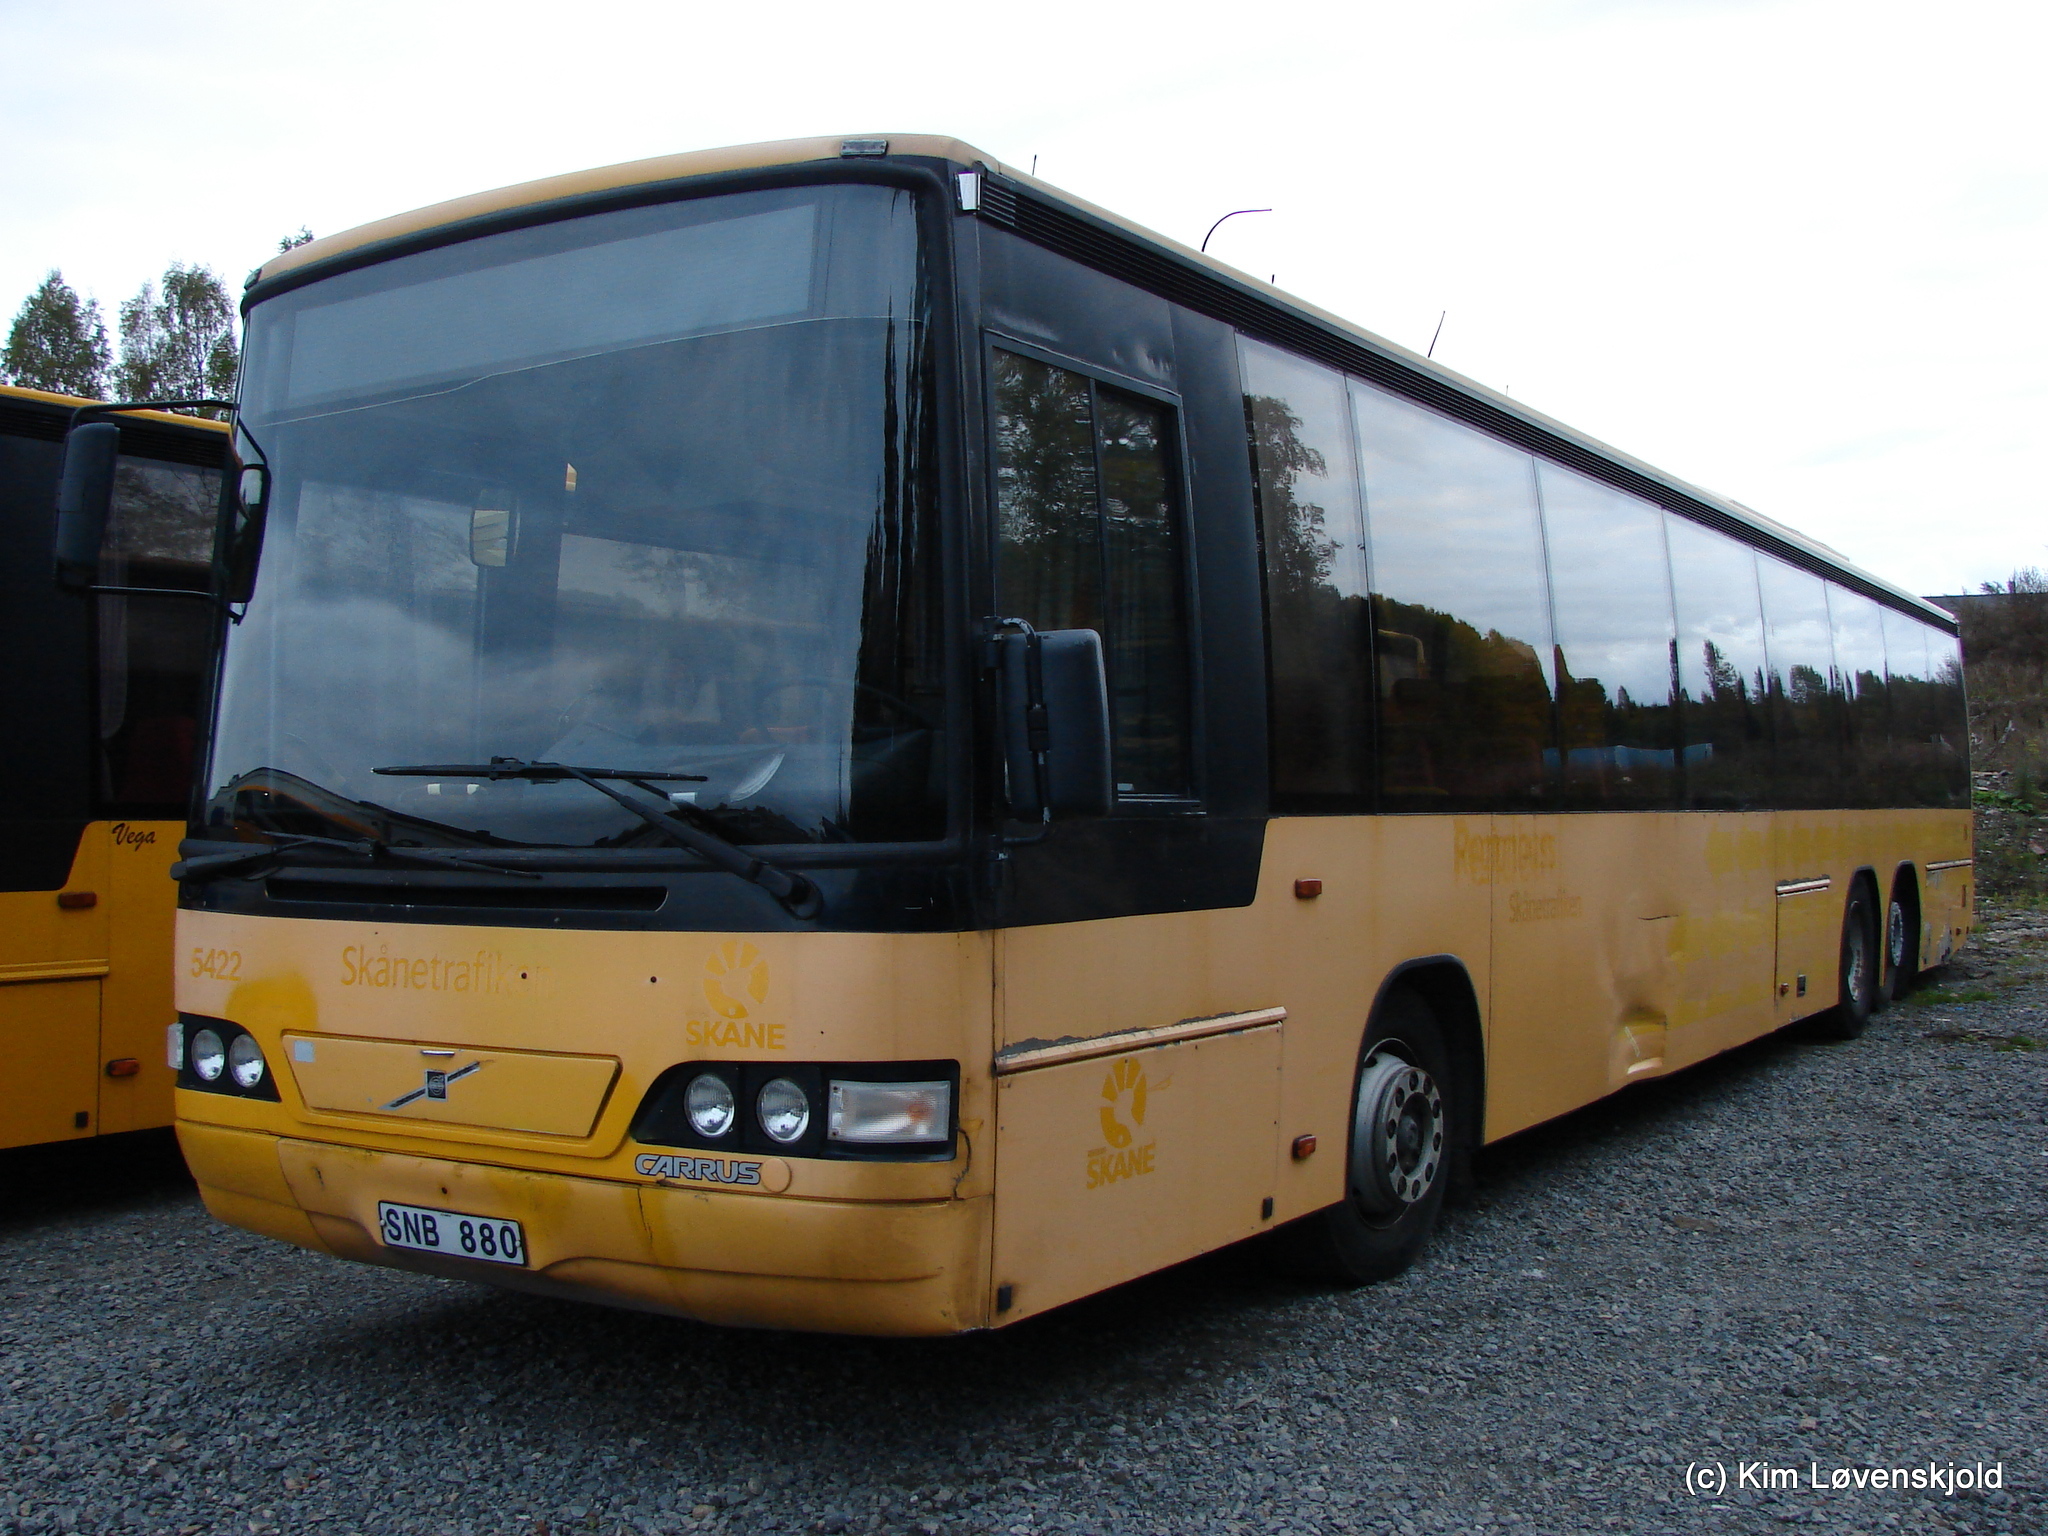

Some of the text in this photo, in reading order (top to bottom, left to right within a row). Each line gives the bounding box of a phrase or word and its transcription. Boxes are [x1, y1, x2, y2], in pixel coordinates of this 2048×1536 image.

[111, 822, 156, 852] Vega
[190, 947, 242, 981] 5422
[635, 1153, 762, 1185] CARRUS
[386, 1208, 518, 1259] SNB 880
